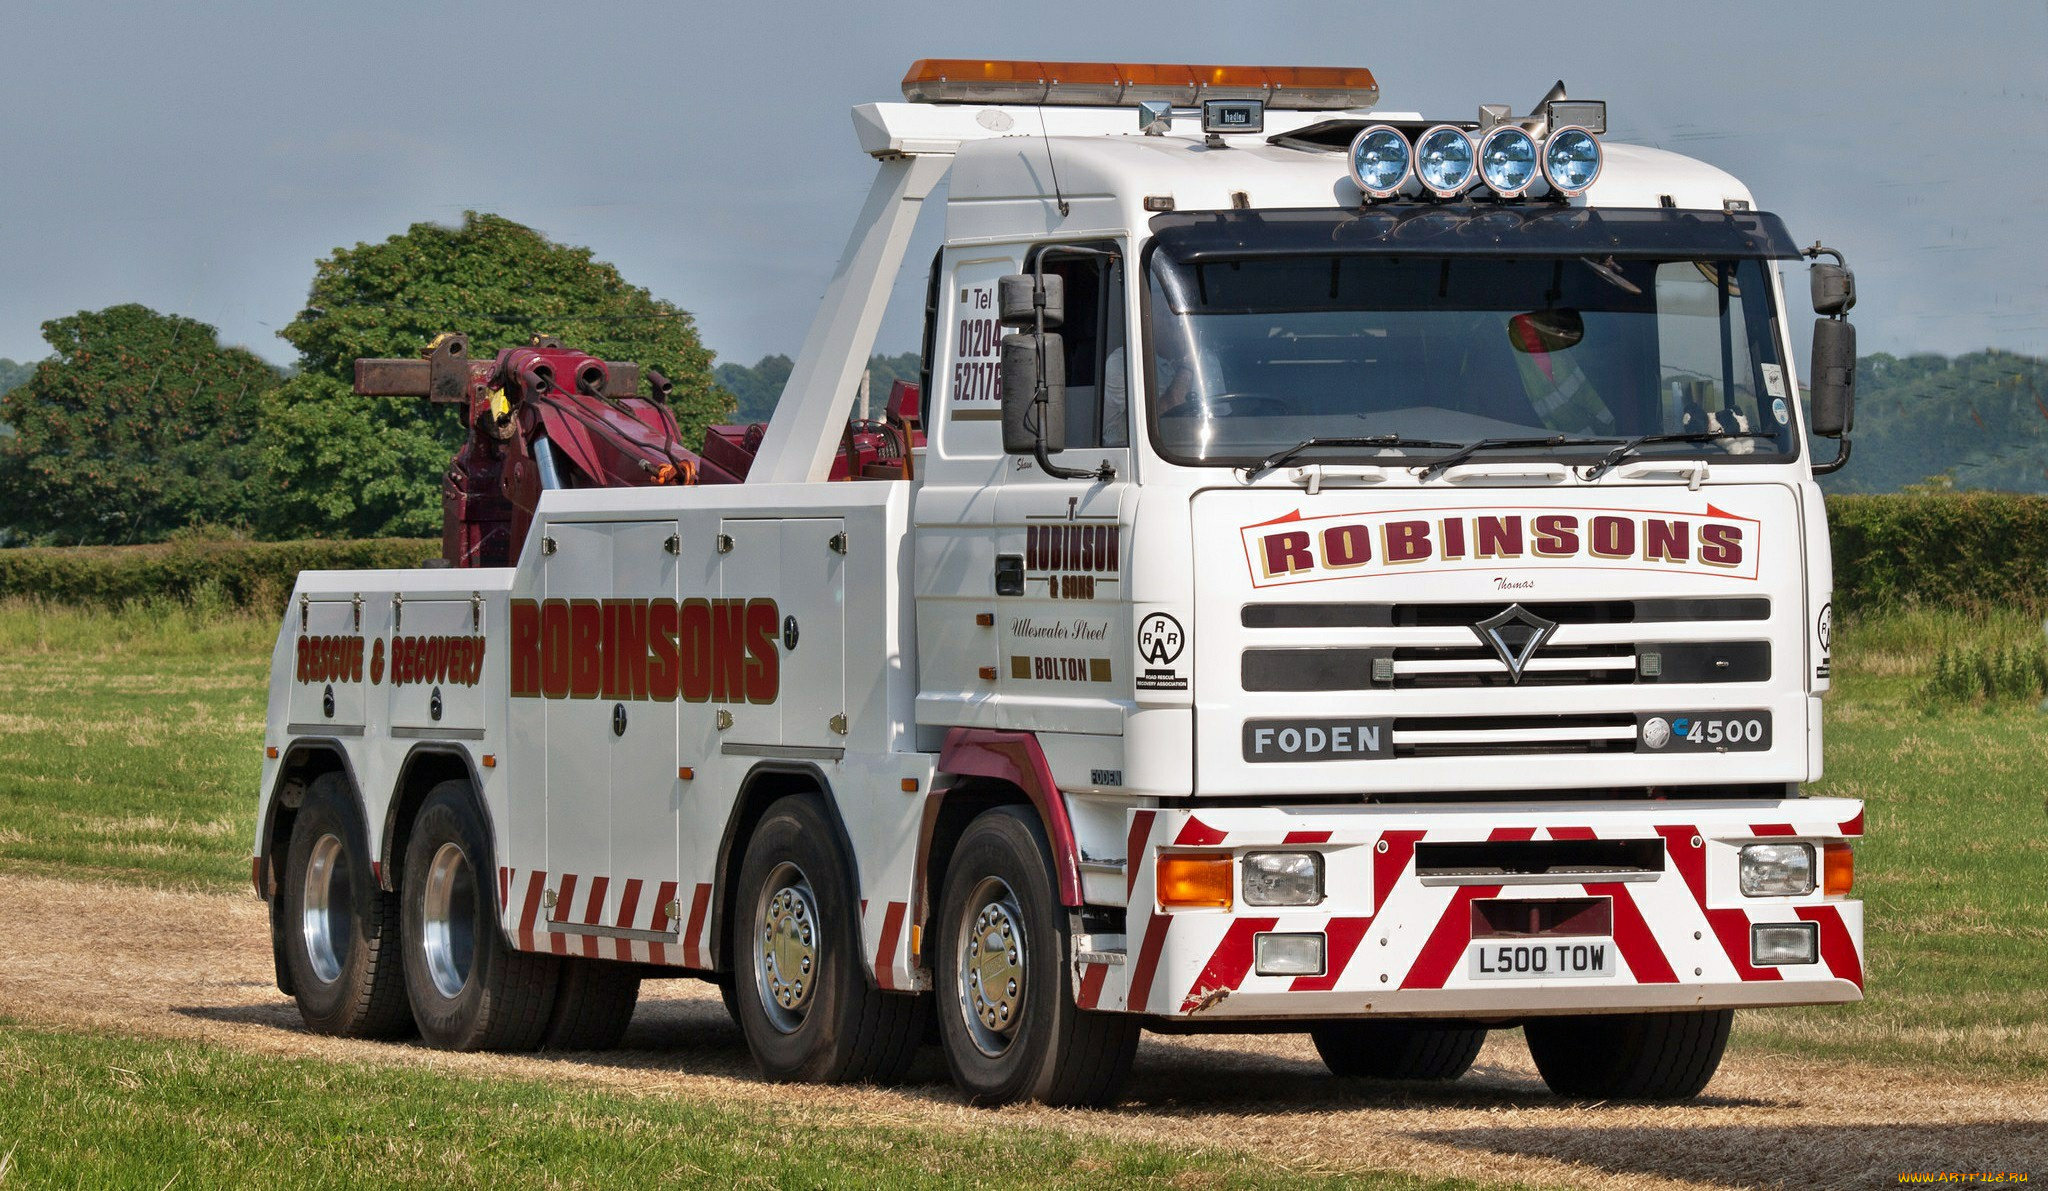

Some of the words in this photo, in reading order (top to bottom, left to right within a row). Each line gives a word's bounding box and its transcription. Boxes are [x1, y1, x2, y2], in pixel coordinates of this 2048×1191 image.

[1224, 109, 1246, 123] hadley
[973, 288, 993, 310] Tel
[959, 319, 1002, 357] 01204
[953, 362, 1002, 401] 527176
[1068, 497, 1079, 521] T
[1026, 525, 1120, 572] ROBINSON
[1257, 514, 1743, 580] ROBINSONS
[1049, 575, 1059, 599] &
[1061, 575, 1095, 600] SONS
[1493, 577, 1536, 591] Thomas
[1010, 617, 1068, 639] Ulleswater
[1071, 618, 1108, 641] Street
[297, 634, 365, 686] RESCUE
[370, 637, 385, 686] &
[390, 634, 486, 688] RECOVERY
[510, 598, 780, 705] ROBINSONS
[1034, 656, 1088, 682] BOLTON
[1255, 725, 1380, 754] FODEN
[1091, 769, 1122, 786] FODEN
[1479, 946, 1547, 974] L500
[1555, 944, 1605, 973] TOW
